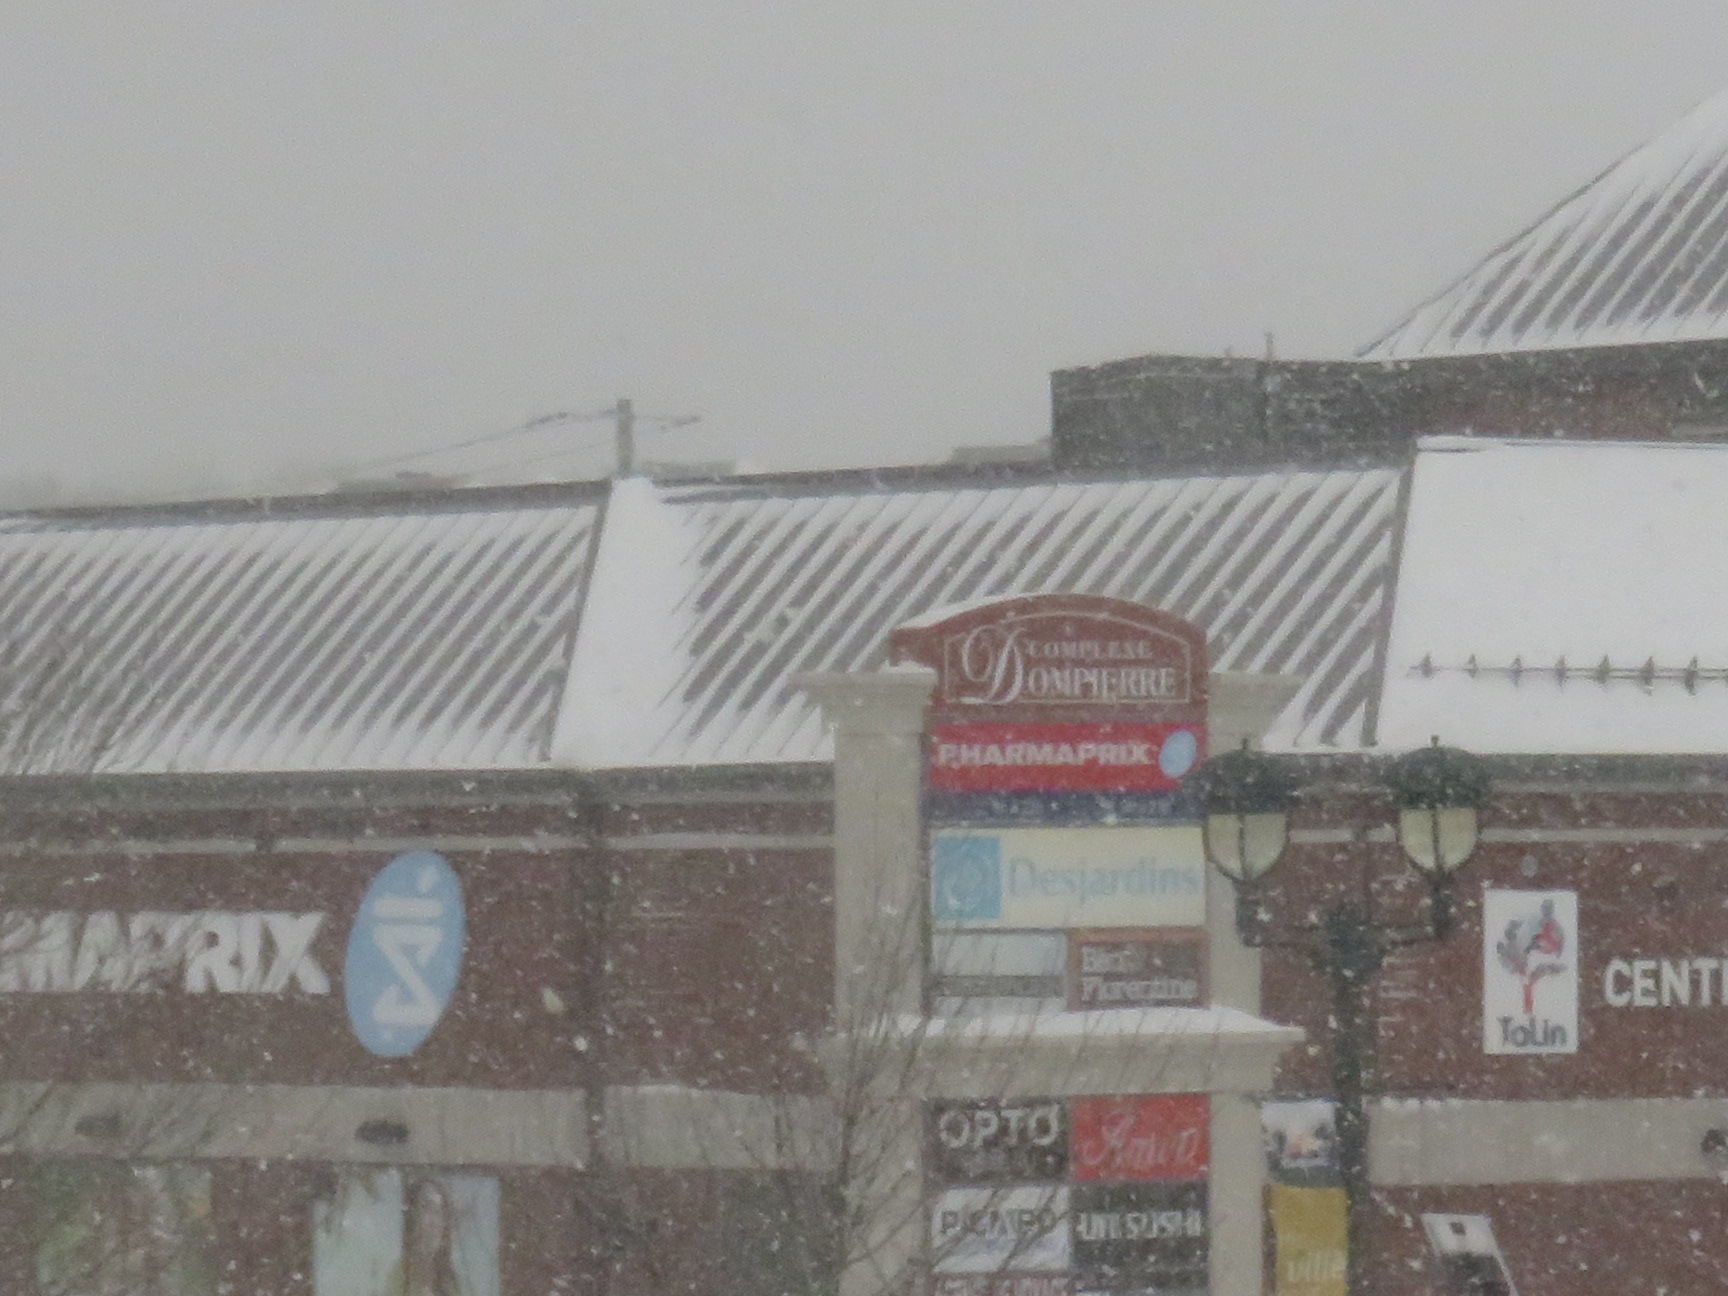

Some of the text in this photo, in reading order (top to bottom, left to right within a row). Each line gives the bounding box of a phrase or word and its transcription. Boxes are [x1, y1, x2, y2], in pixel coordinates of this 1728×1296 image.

[960, 623, 1177, 705] DOMPIERRE
[936, 742, 1152, 766] PHARMAPRIX
[1008, 857, 1204, 907] Desjardins
[938, 1104, 1062, 1149] OPTO
